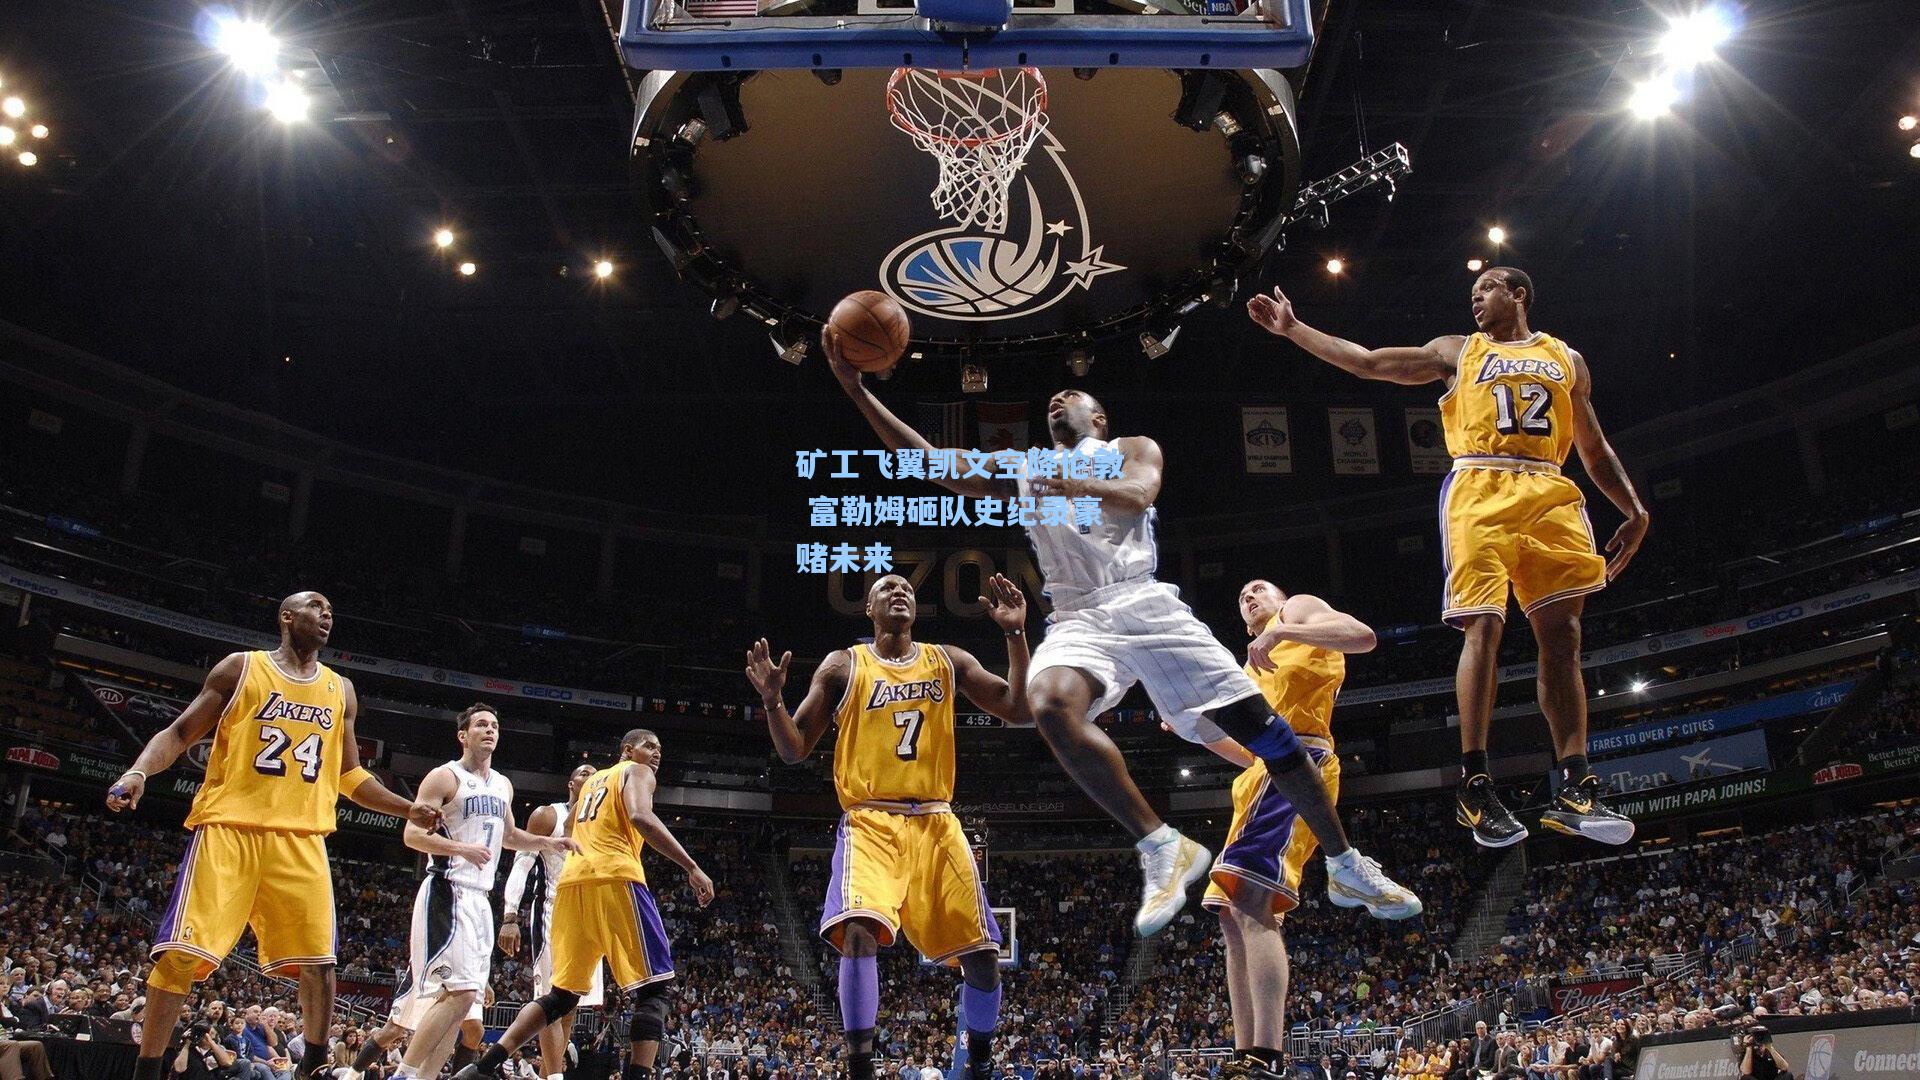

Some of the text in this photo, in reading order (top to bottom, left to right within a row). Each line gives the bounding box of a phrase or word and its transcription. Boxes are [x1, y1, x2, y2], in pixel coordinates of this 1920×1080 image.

[1211, 3, 1232, 11] NBA
[1475, 353, 1567, 384] LAKERS
[1492, 383, 1552, 436] 12
[1747, 606, 1804, 629] GEICO
[1506, 665, 1536, 678] Amway
[99, 690, 119, 701] KIA
[522, 685, 572, 700] GEICO
[865, 679, 945, 711] LAKERS
[254, 691, 333, 731] LAKERS
[966, 715, 991, 726] 4:52
[894, 710, 925, 760] 7
[1593, 735, 1622, 752] FARES
[1625, 733, 1637, 746] TO
[1640, 728, 1665, 743] OVER
[1682, 718, 1715, 735] CITIES
[70, 752, 95, 767] Better
[254, 724, 323, 783] 24
[80, 766, 106, 780] Better
[577, 787, 608, 823] 17
[1618, 800, 1644, 816] WIN
[1649, 794, 1680, 812] WITH
[1684, 788, 1716, 806] PAPA
[1720, 777, 1767, 800] JOHNS!
[355, 810, 400, 829] JOHNS!
[482, 821, 494, 848] 7
[1658, 1060, 1699, 1079] Connect
[1700, 1060, 1713, 1077] at
